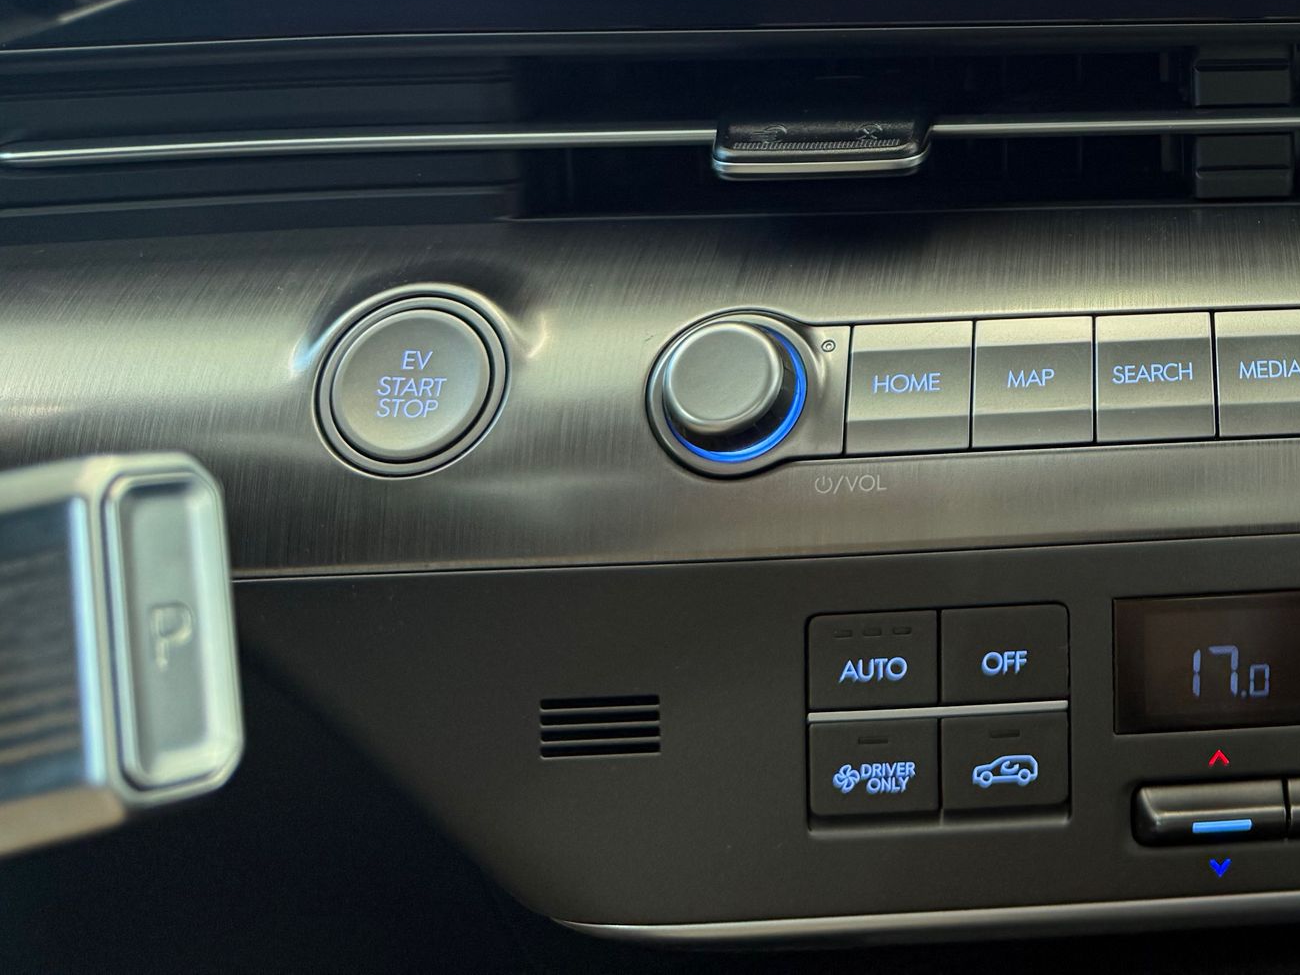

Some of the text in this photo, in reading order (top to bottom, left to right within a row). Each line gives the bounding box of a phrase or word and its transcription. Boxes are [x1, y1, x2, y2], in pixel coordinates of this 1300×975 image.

[402, 350, 434, 370] EV
[872, 372, 941, 394] HOME
[1006, 368, 1056, 388] MAP
[1112, 361, 1194, 385] SEARCH
[377, 376, 448, 396] START
[376, 398, 439, 418] STOP
[150, 602, 194, 669] P
[838, 656, 908, 683] AUTO
[981, 650, 1028, 676] OFF
[1193, 645, 1270, 698] 17.0
[860, 762, 916, 779] DRIVER
[866, 777, 910, 794] ONLY
